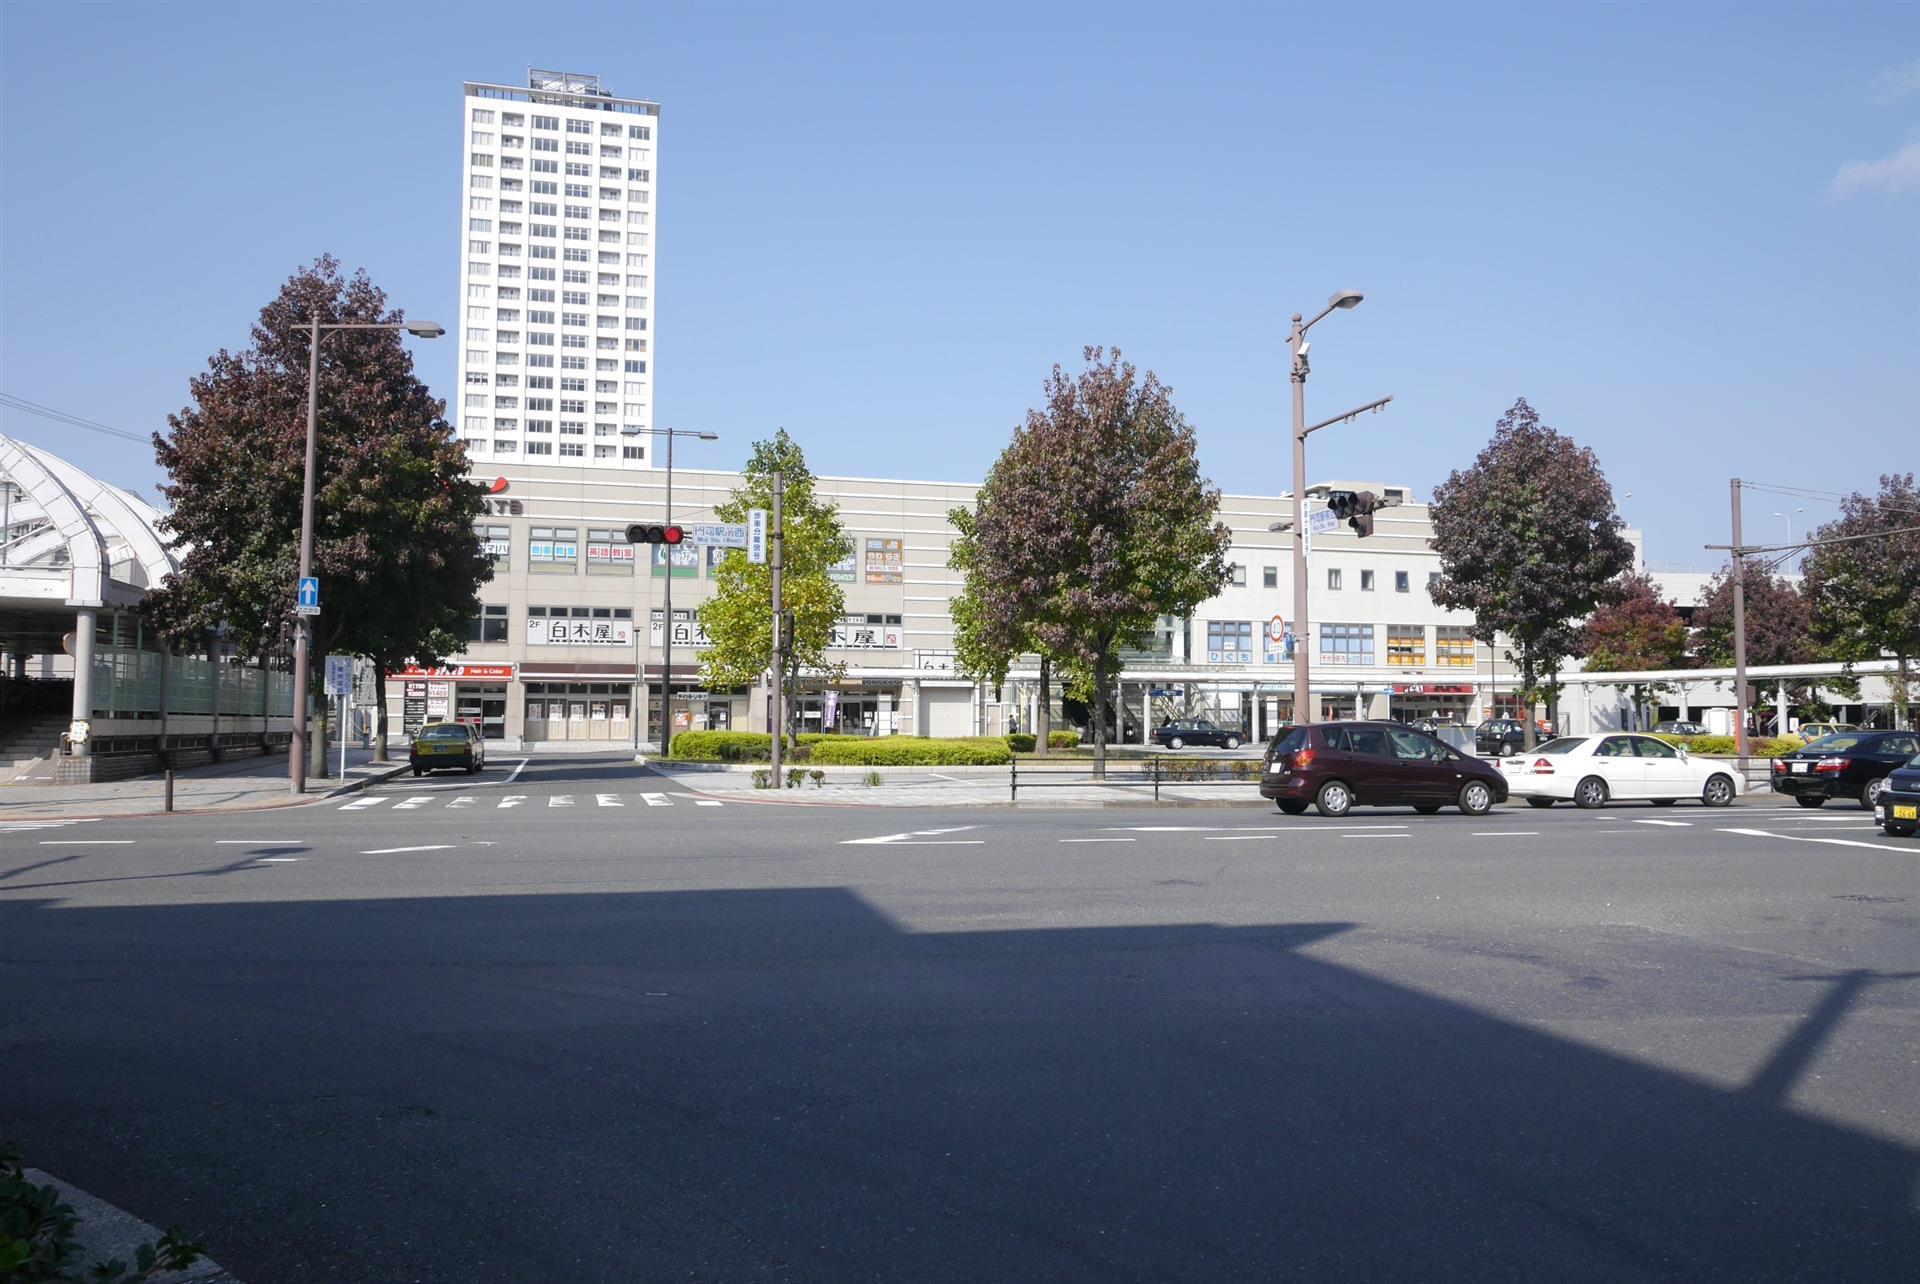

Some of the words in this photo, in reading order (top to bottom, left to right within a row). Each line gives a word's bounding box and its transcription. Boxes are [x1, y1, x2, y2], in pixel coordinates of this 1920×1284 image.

[694, 526, 745, 537] 門司駅前西
[753, 511, 761, 560] 歩車分離信号
[588, 547, 634, 558] 英語教室
[552, 622, 612, 639] 白木屋
[652, 623, 664, 631] 2F
[1273, 623, 1281, 635] 40
[1210, 652, 1249, 662] ひぐち
